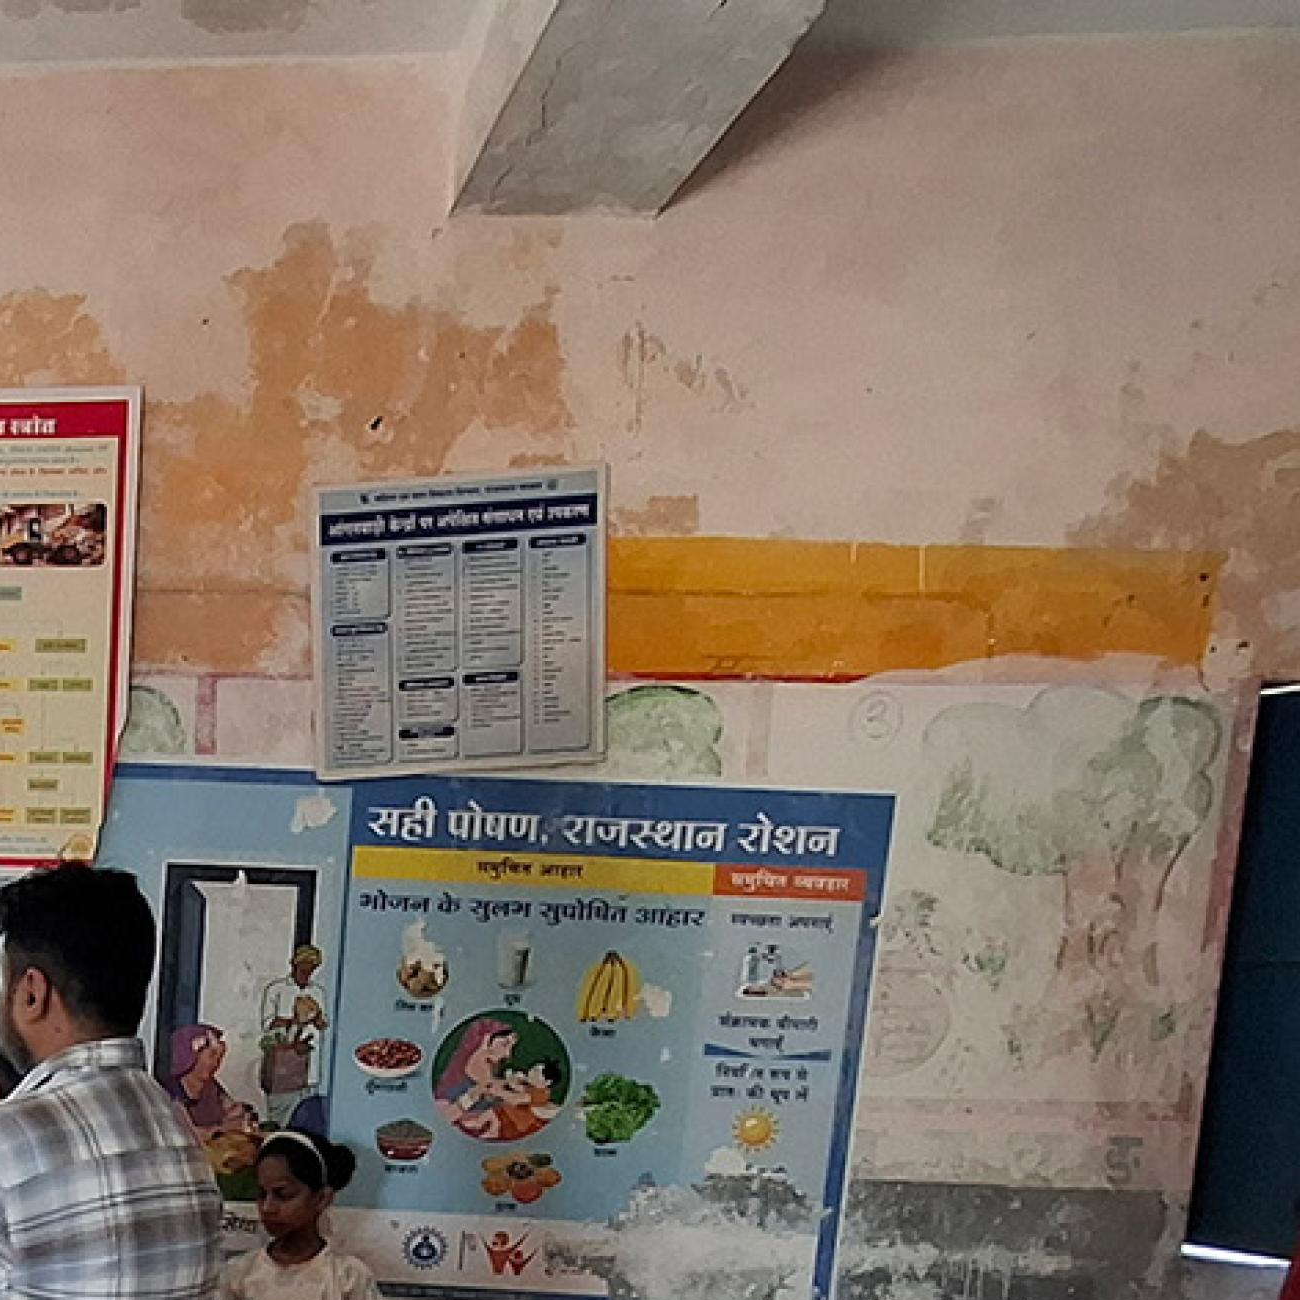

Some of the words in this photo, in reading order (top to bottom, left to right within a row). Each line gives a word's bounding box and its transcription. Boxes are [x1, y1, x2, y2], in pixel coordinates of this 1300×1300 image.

[367, 796, 437, 841] सही
[448, 799, 549, 845] पोषण,
[562, 813, 728, 852] राजस्थान
[737, 812, 842, 856] रोशन
[360, 889, 430, 913] भोजन
[437, 892, 461, 914] के
[470, 899, 532, 922] सुलभ
[539, 897, 628, 926] सुपोषित
[635, 907, 705, 928] आहार
